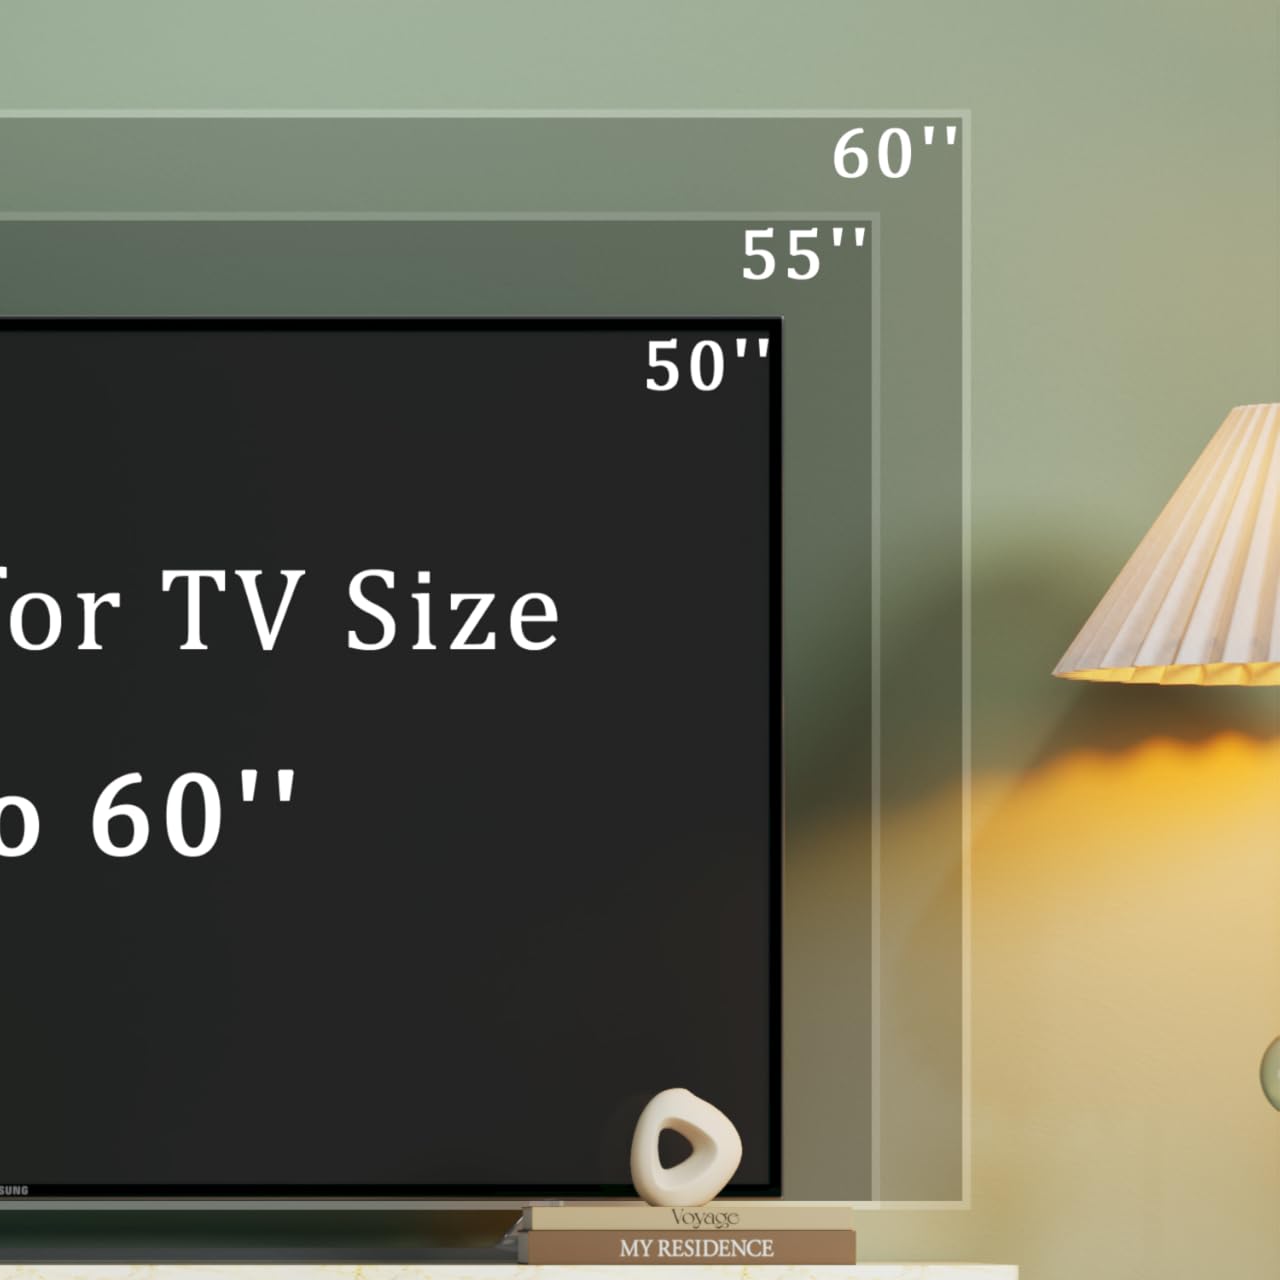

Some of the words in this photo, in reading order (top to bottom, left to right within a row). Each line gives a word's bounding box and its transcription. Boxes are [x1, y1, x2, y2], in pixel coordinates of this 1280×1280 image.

[671, 1207, 740, 1229] Voyage
[620, 1239, 653, 1258] MY
[657, 1239, 774, 1258] RESIDENCE
